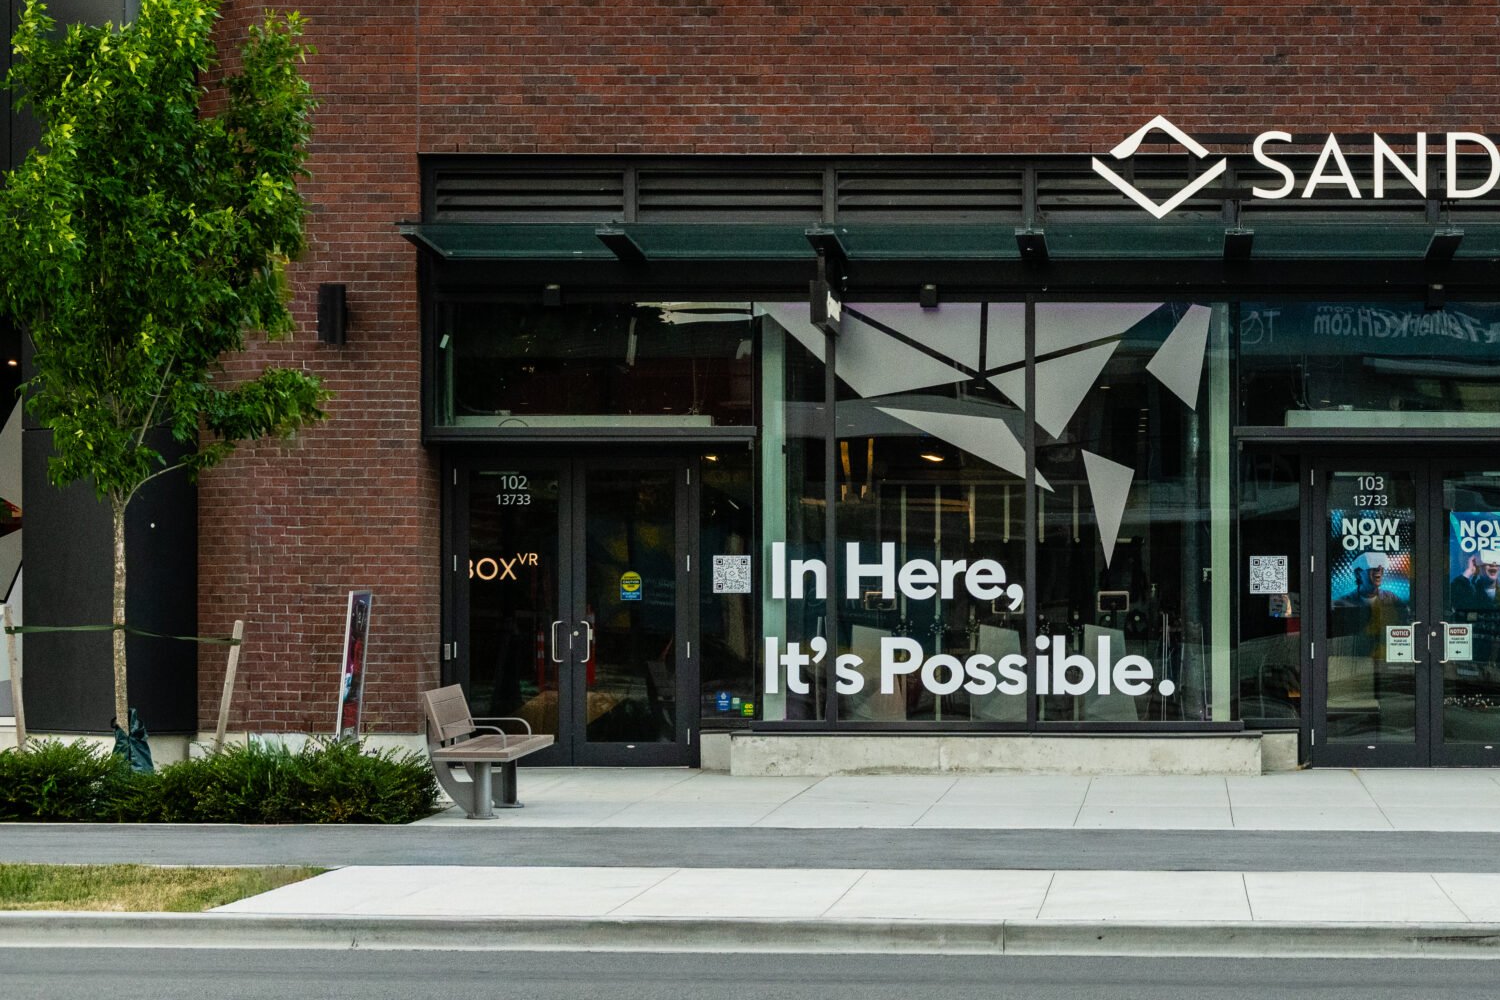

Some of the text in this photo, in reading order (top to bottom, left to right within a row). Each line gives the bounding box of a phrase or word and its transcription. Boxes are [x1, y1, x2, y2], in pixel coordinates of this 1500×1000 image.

[500, 475, 528, 490] 102
[1357, 476, 1385, 491] 103
[495, 494, 531, 505] 13733
[1353, 495, 1388, 506] 13733
[1342, 518, 1400, 536] NOW
[1342, 535, 1400, 551] OPEN
[516, 553, 538, 566] VR
[771, 541, 1025, 611] In Here,
[764, 634, 1176, 696] It’s Possible.
